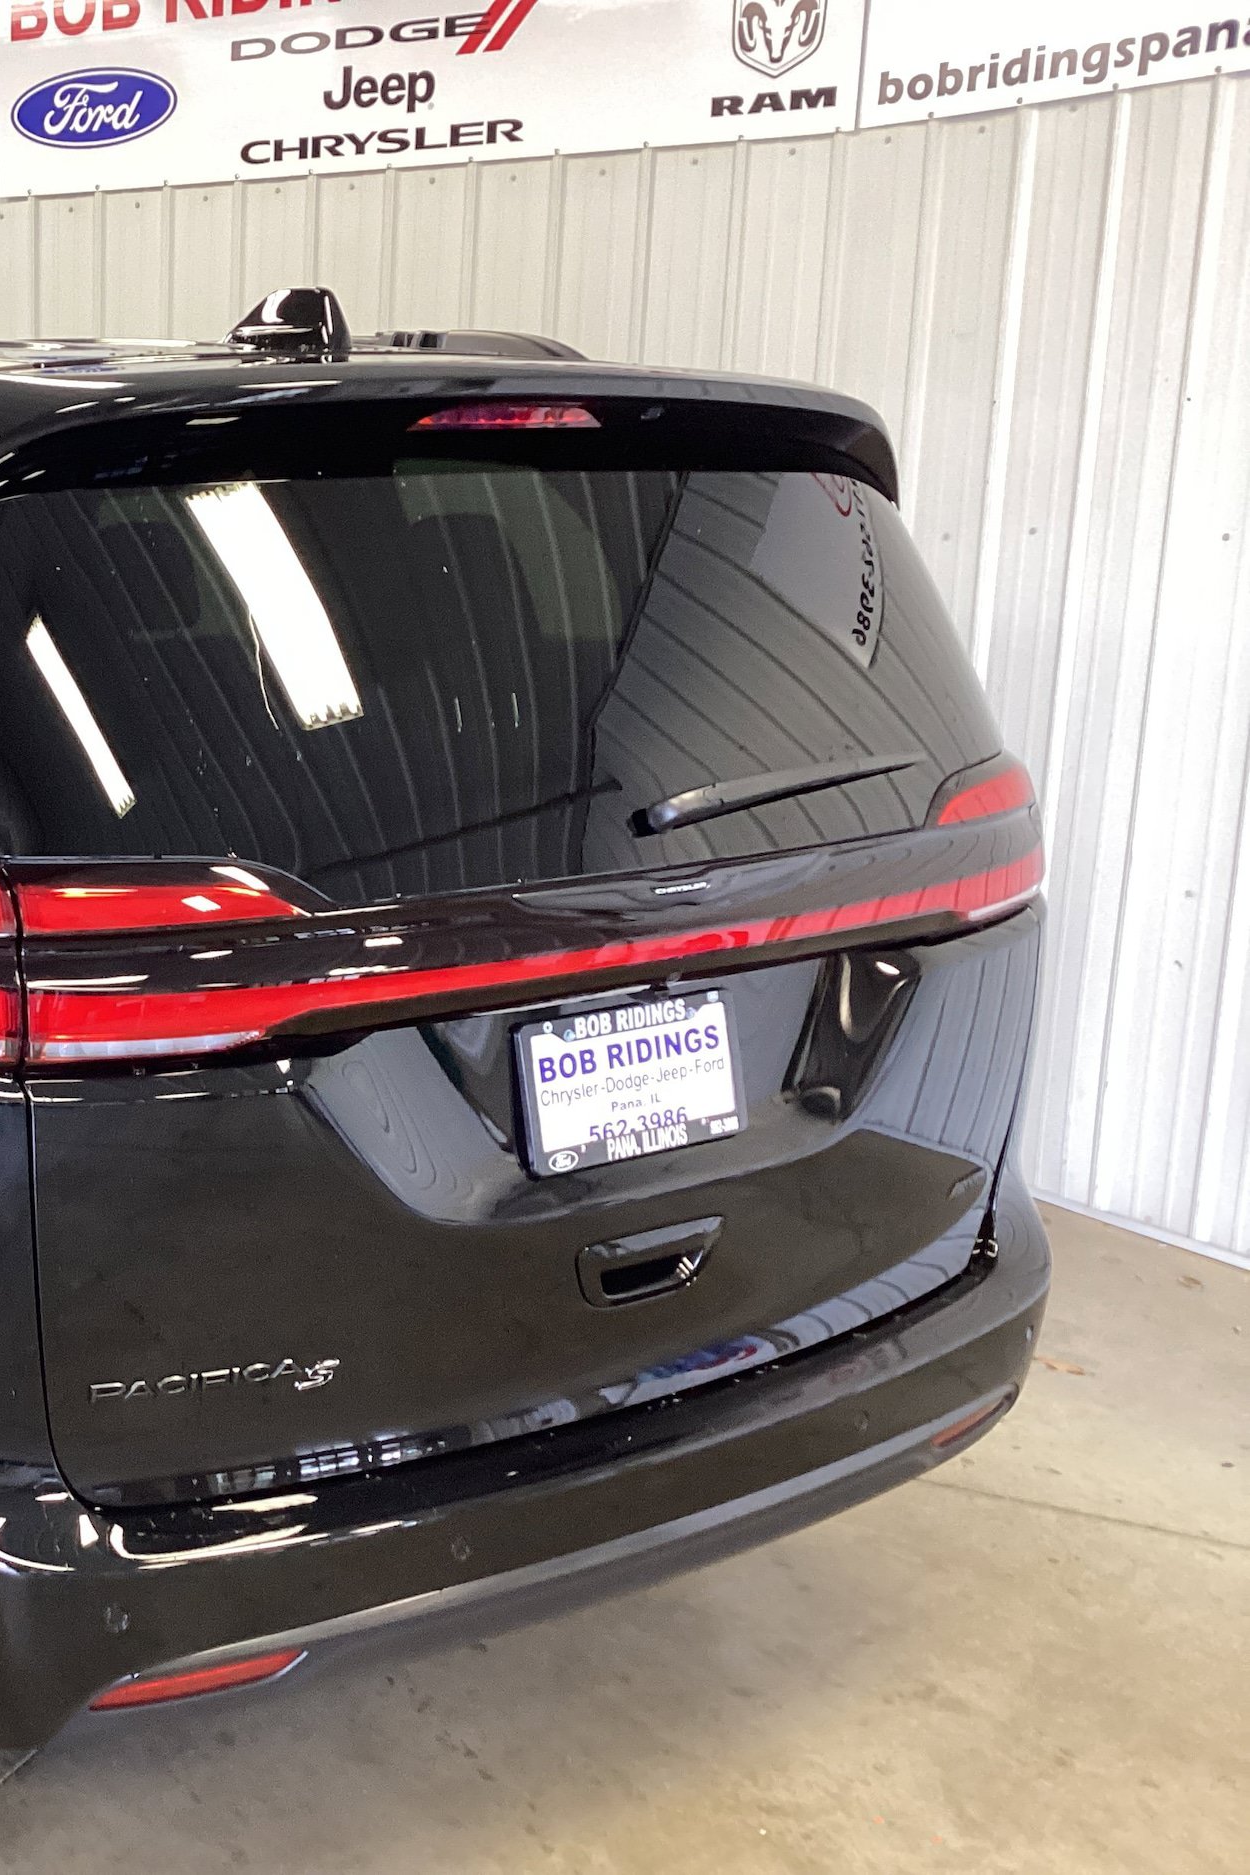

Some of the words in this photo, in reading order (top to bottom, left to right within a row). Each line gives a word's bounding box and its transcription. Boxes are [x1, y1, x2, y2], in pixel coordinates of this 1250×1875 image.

[230, 12, 491, 62] DODGE
[877, 17, 1250, 105] bobridingspan
[43, 81, 144, 135] Ford
[323, 65, 431, 113] Jeep
[710, 86, 838, 118] RAM
[240, 118, 524, 165] CHRYSLER
[574, 1012, 612, 1039] BOB
[616, 999, 686, 1032] RIDINGS
[538, 1049, 597, 1083] BOB
[607, 1025, 720, 1069] RIDINGS
[650, 1093, 662, 1104] IL
[642, 1122, 688, 1153] ILLINOIS
[90, 1358, 301, 1403] PACIFICA
